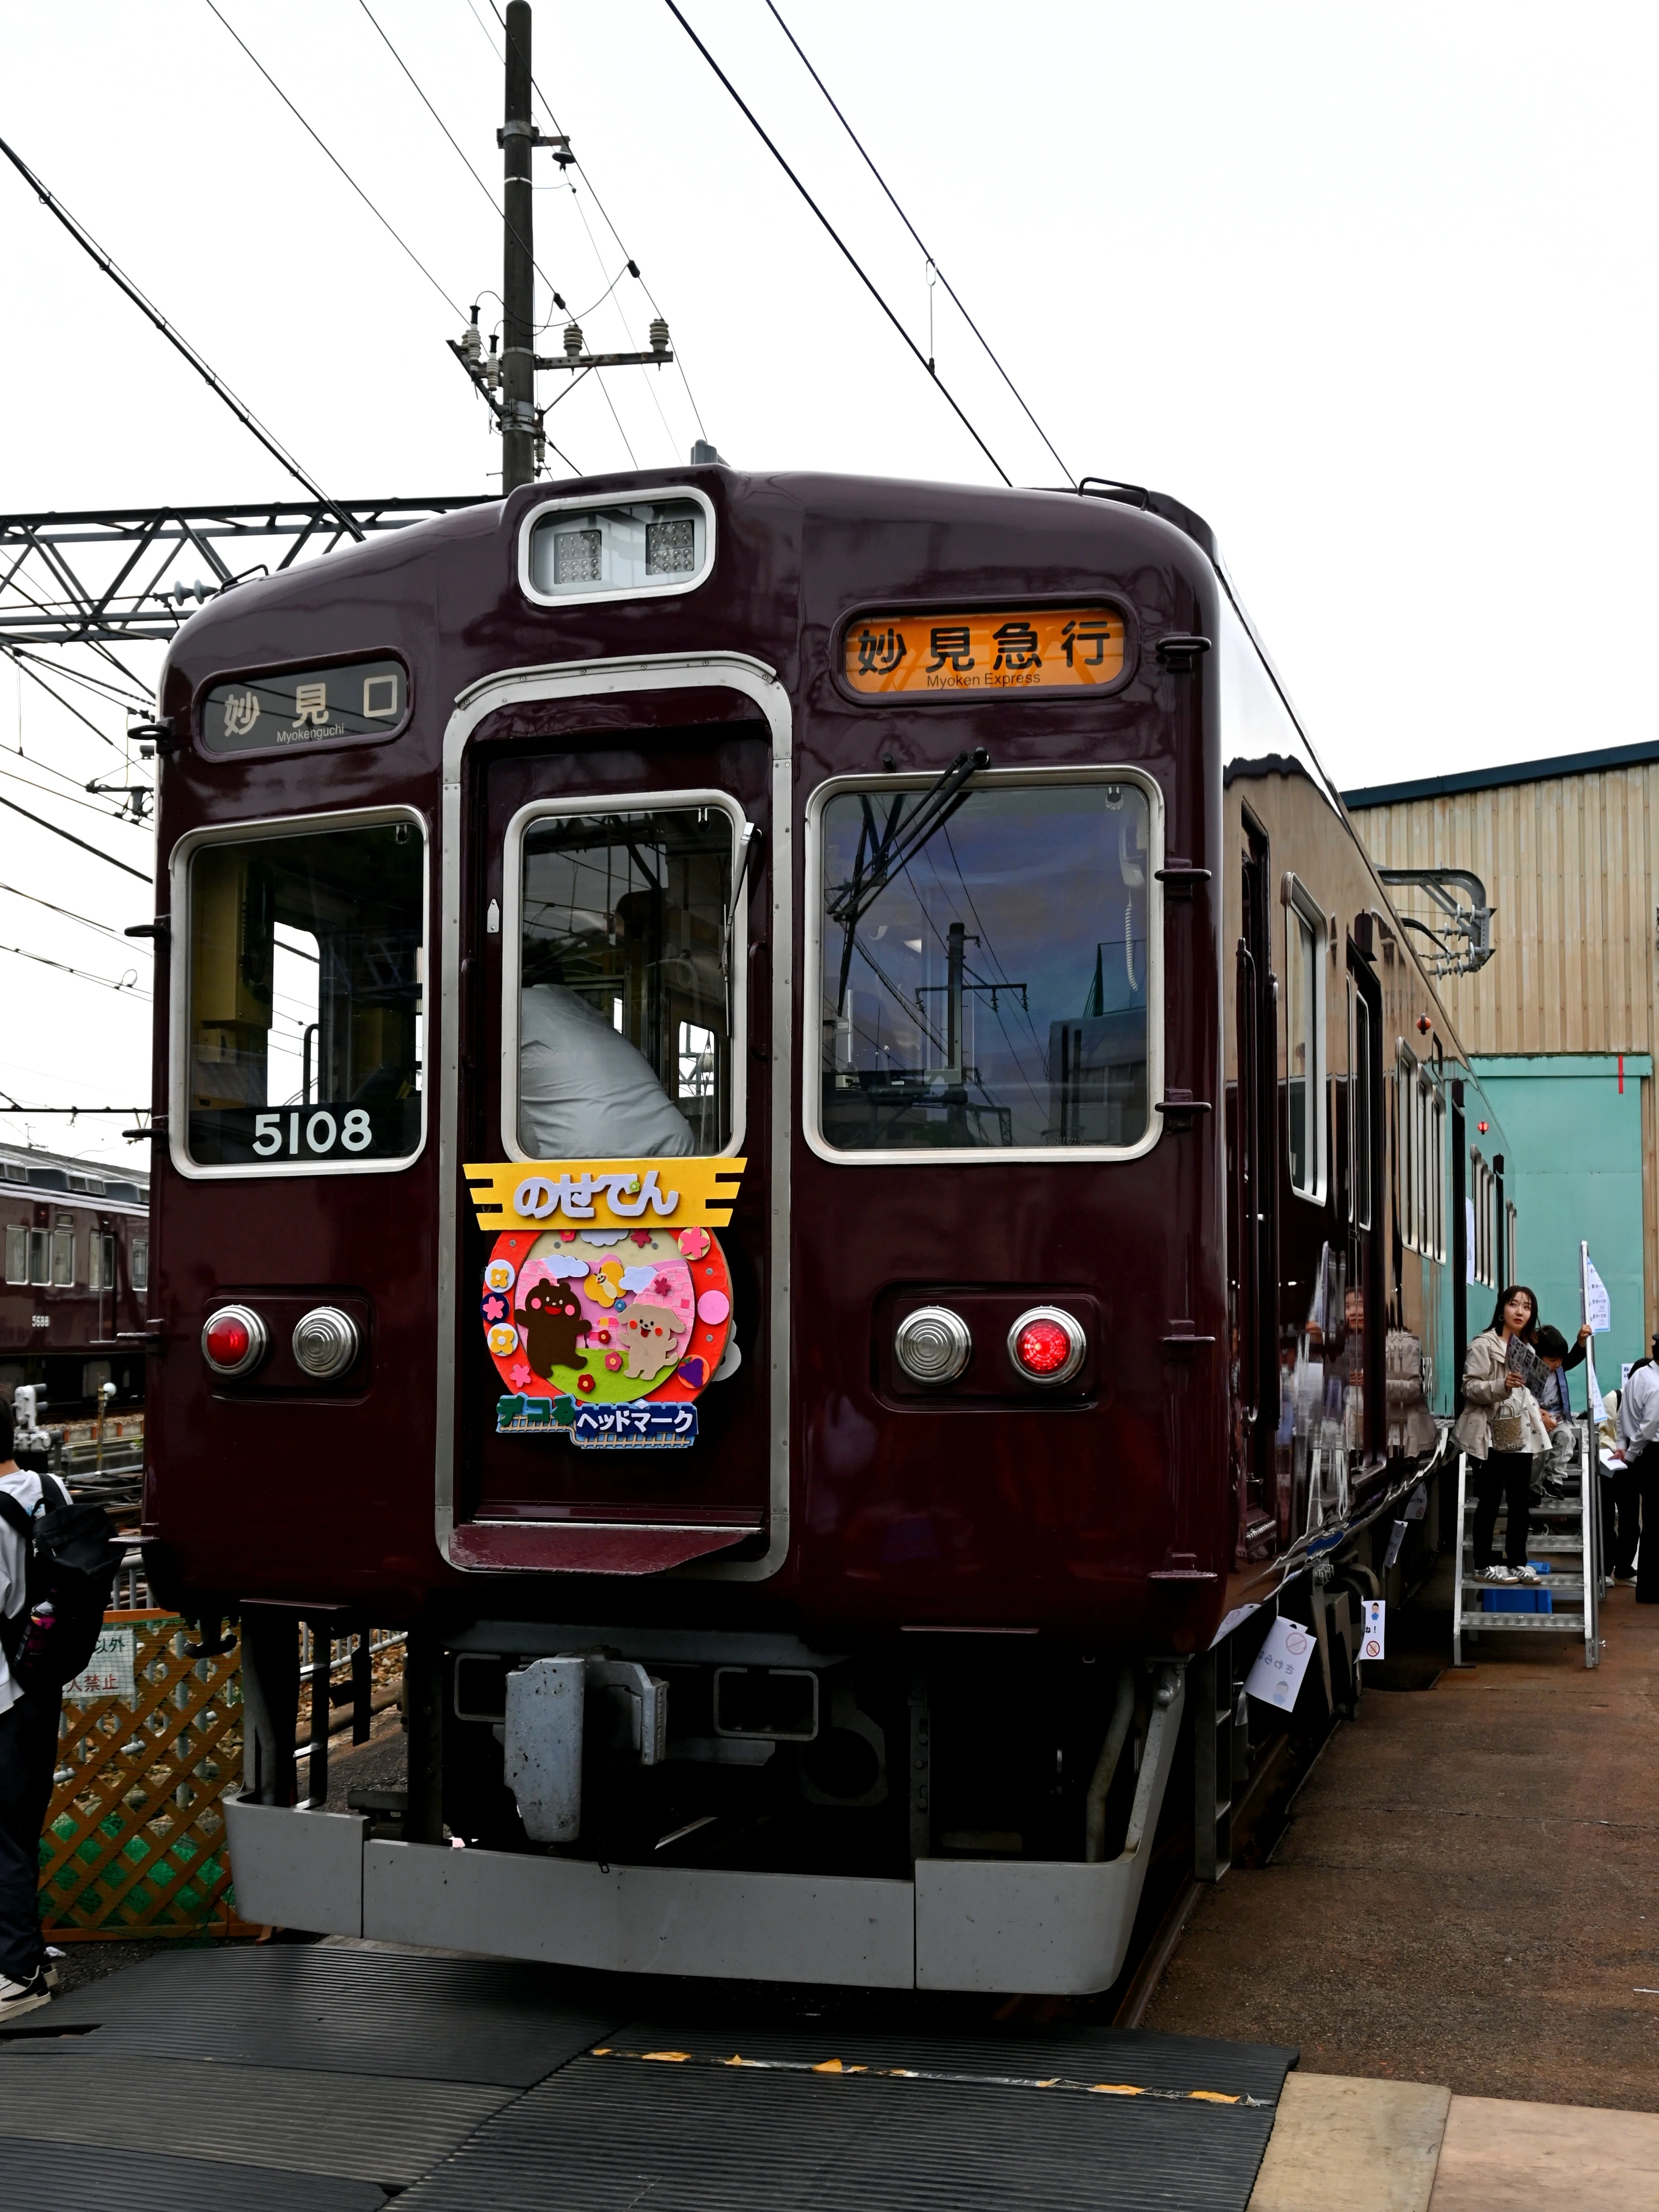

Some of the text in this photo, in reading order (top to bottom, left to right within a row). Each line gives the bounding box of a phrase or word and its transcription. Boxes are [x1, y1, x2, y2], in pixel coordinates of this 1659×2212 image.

[857, 620, 1111, 676] 妙見急行
[927, 673, 1040, 690] Myoken Express
[224, 674, 397, 737] 妙見口
[277, 723, 344, 744] Myokenguchi
[252, 1109, 372, 1156] 5108
[496, 1395, 576, 1426] デコる
[577, 1410, 693, 1433] ヘッドマーク
